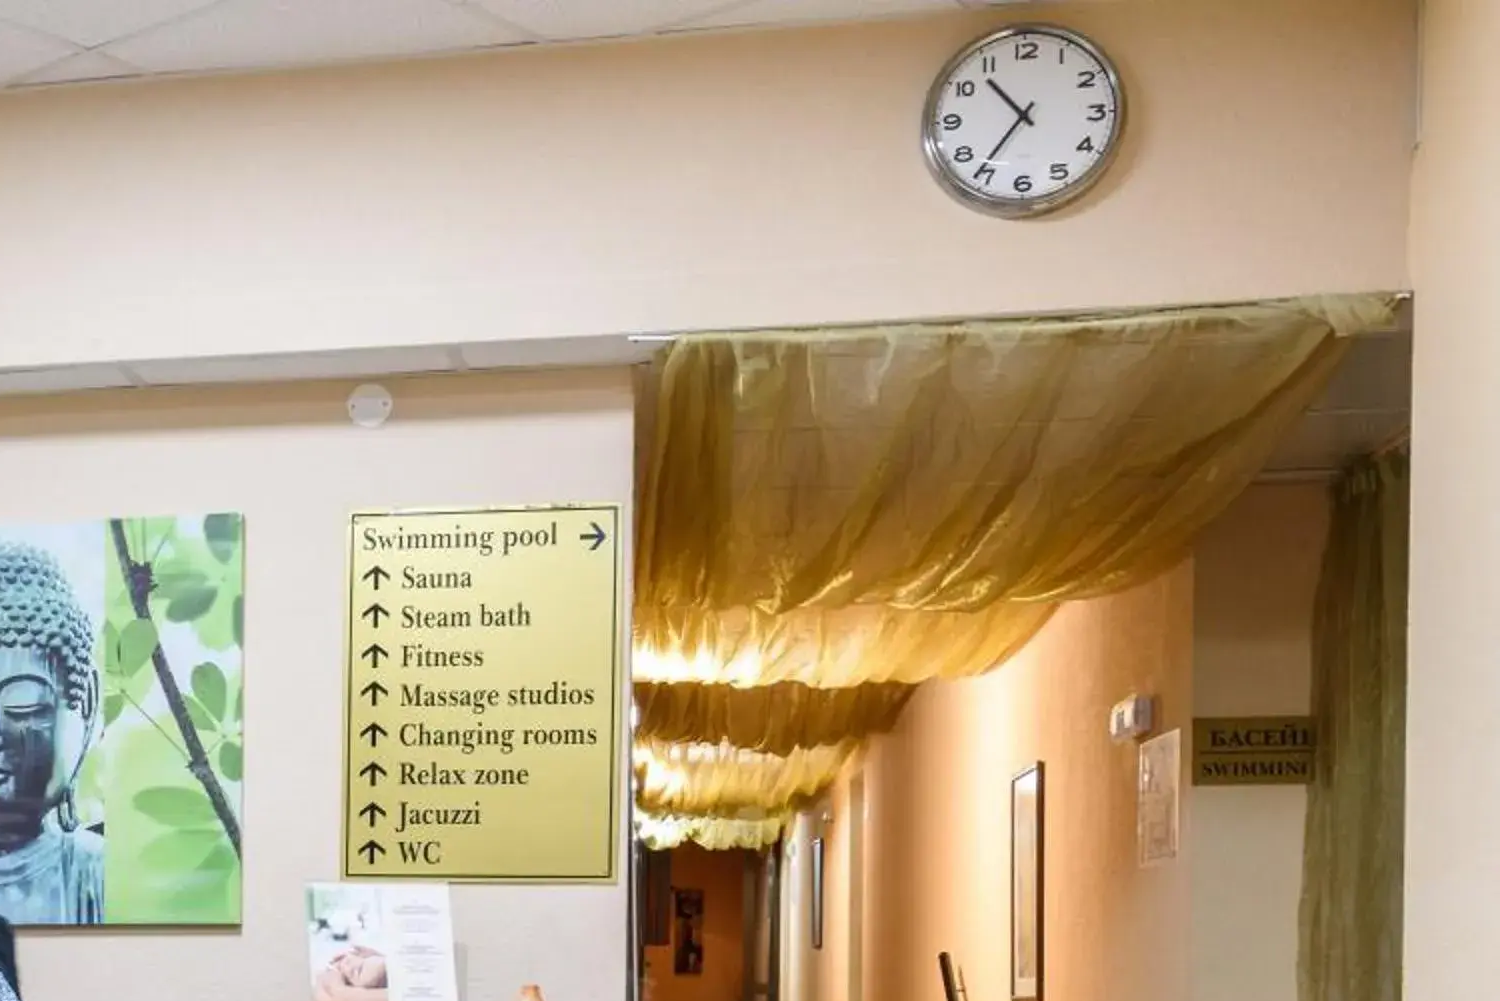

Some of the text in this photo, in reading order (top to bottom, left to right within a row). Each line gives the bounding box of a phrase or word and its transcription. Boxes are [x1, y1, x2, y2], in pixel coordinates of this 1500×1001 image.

[1014, 42, 1039, 61] 12
[1058, 48, 1064, 64] 1
[982, 56, 996, 73] 11
[955, 80, 975, 97] 10
[1076, 71, 1096, 88] 2
[942, 113, 962, 130] 9
[1086, 103, 1106, 121] 3
[953, 145, 974, 163] 8
[1075, 136, 1094, 153] 4
[977, 165, 996, 185] 7
[1049, 163, 1069, 180] 5
[1013, 175, 1032, 192] 6
[363, 521, 558, 556] Swimming pool
[401, 566, 473, 589] Sauna
[401, 602, 531, 628] Steam bath
[400, 643, 484, 667] Fitness
[400, 681, 595, 714] Massage studios
[400, 722, 597, 754] Changing rooms
[399, 761, 529, 786] Relax zone
[395, 801, 481, 832] Jacuzzi
[397, 841, 441, 865] WC
